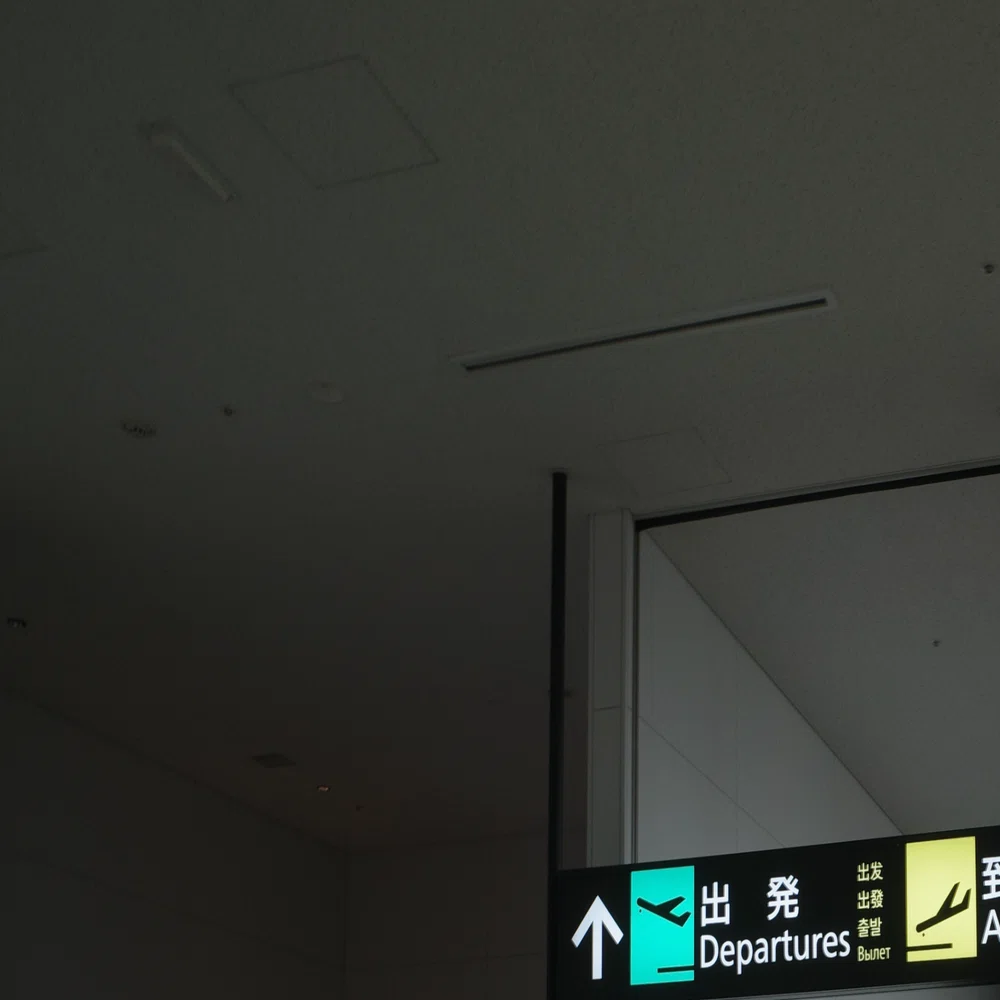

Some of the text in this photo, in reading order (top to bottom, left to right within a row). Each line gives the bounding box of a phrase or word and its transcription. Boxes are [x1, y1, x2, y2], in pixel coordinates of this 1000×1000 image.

[857, 862, 883, 881] 出发
[701, 875, 799, 927] 出発
[858, 889, 883, 909] 出發
[857, 917, 882, 937] 출발
[700, 930, 850, 975] Departures
[858, 946, 891, 961] Вылет
